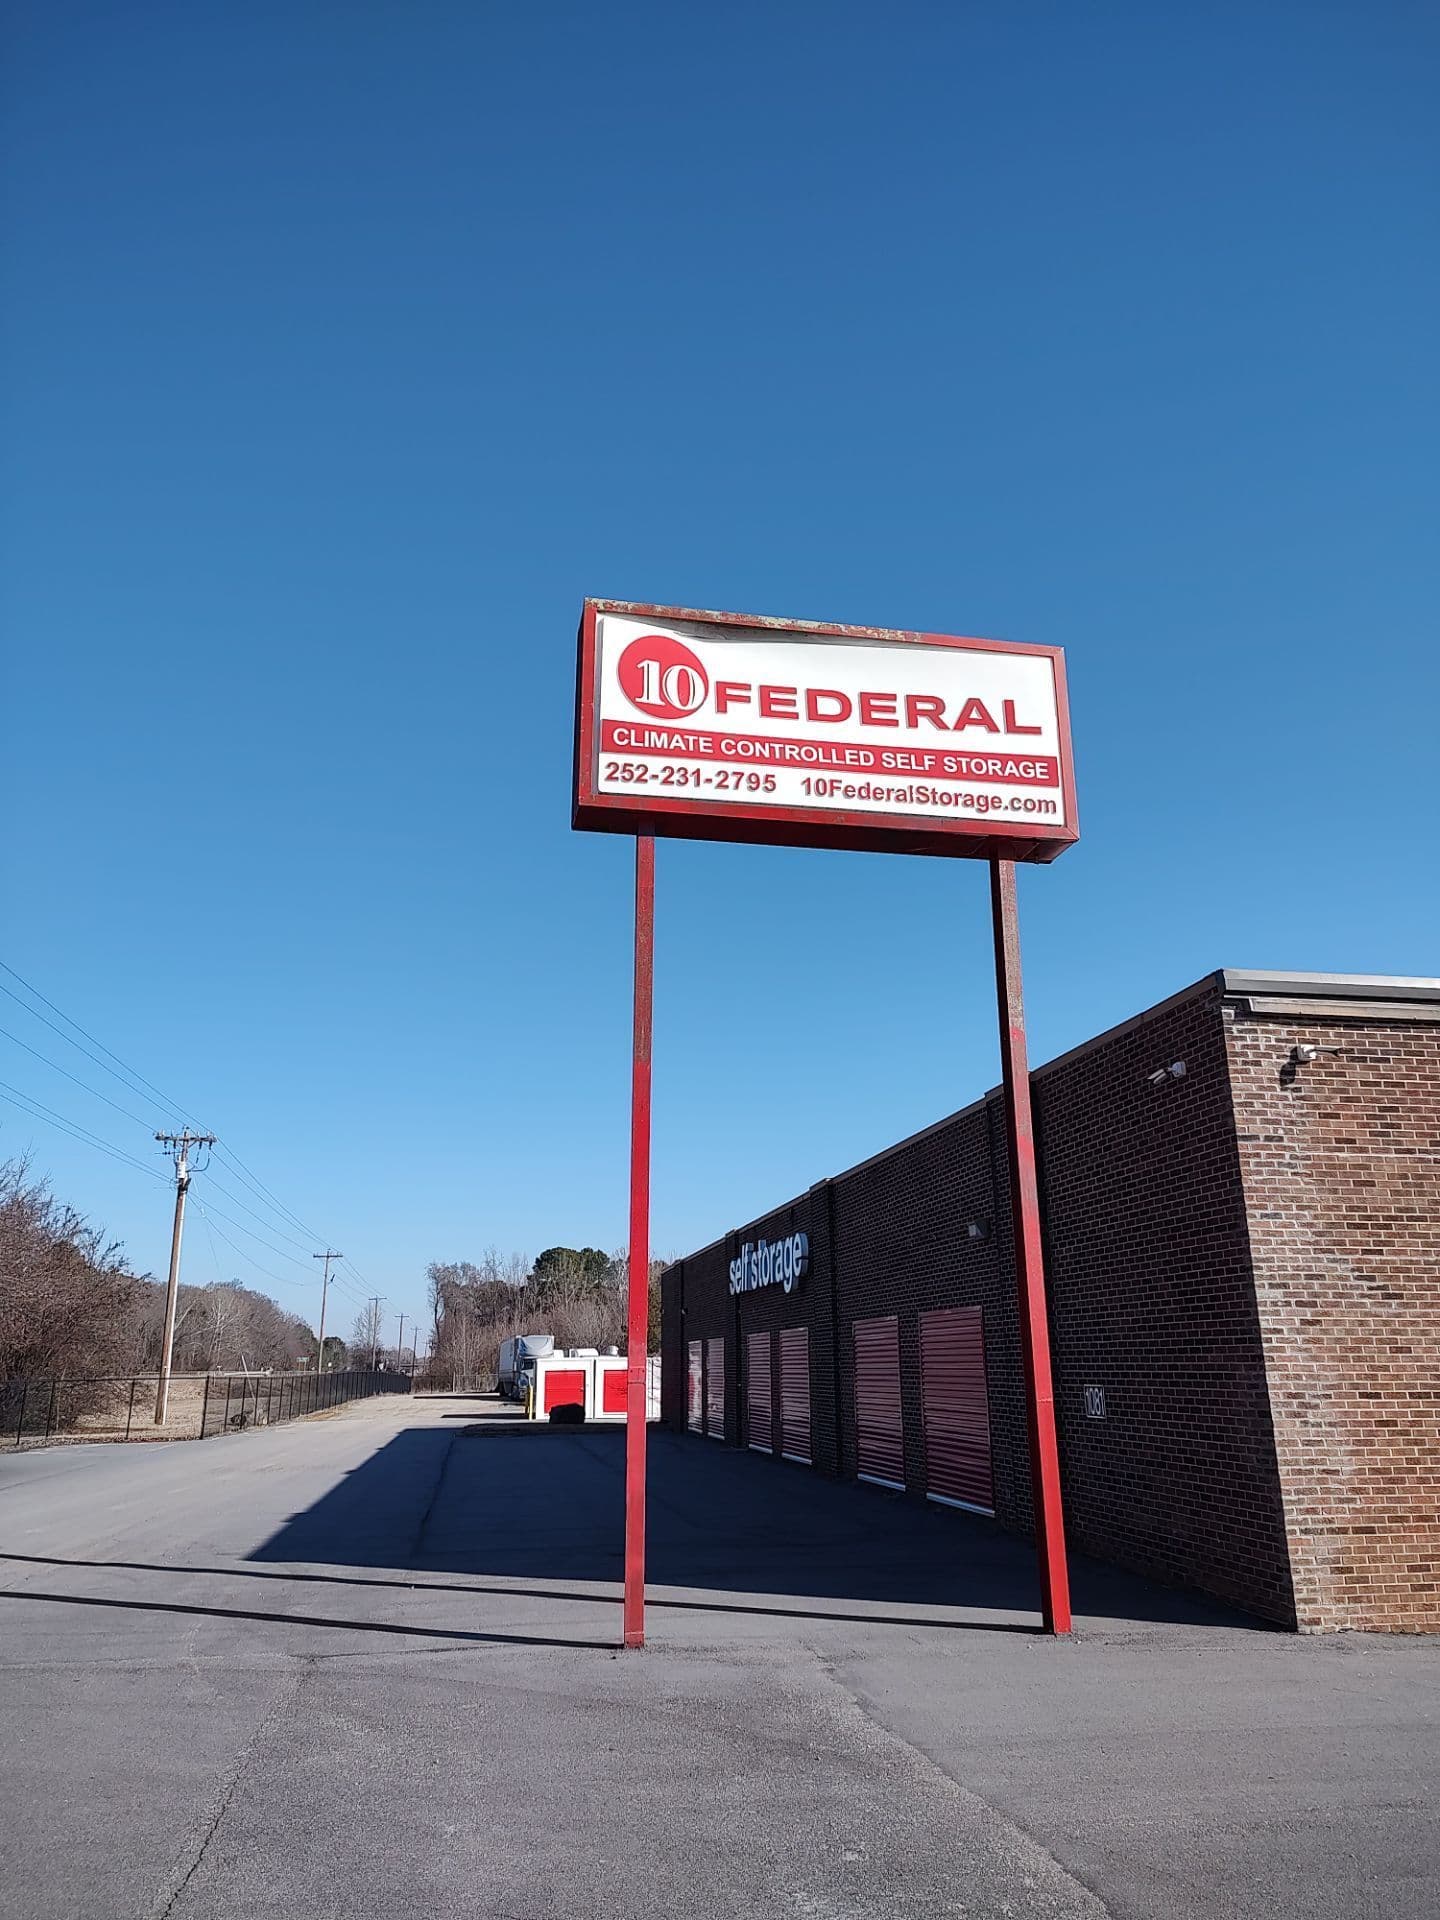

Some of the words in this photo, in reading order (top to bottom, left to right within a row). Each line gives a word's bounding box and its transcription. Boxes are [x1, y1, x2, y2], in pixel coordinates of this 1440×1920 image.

[635, 659, 706, 711] 10
[715, 682, 1042, 735] FEDERAL
[612, 727, 714, 754] CLIMATE
[720, 738, 875, 767] CONTROLLED
[881, 751, 936, 772] SELF
[943, 757, 1050, 780] STORAGE
[605, 762, 776, 792] 252-231-2795
[800, 777, 1057, 814] 10FederalStorage.com
[729, 1243, 751, 1295] self
[751, 1233, 806, 1293] storage
[1085, 1387, 1105, 1416] 1081
